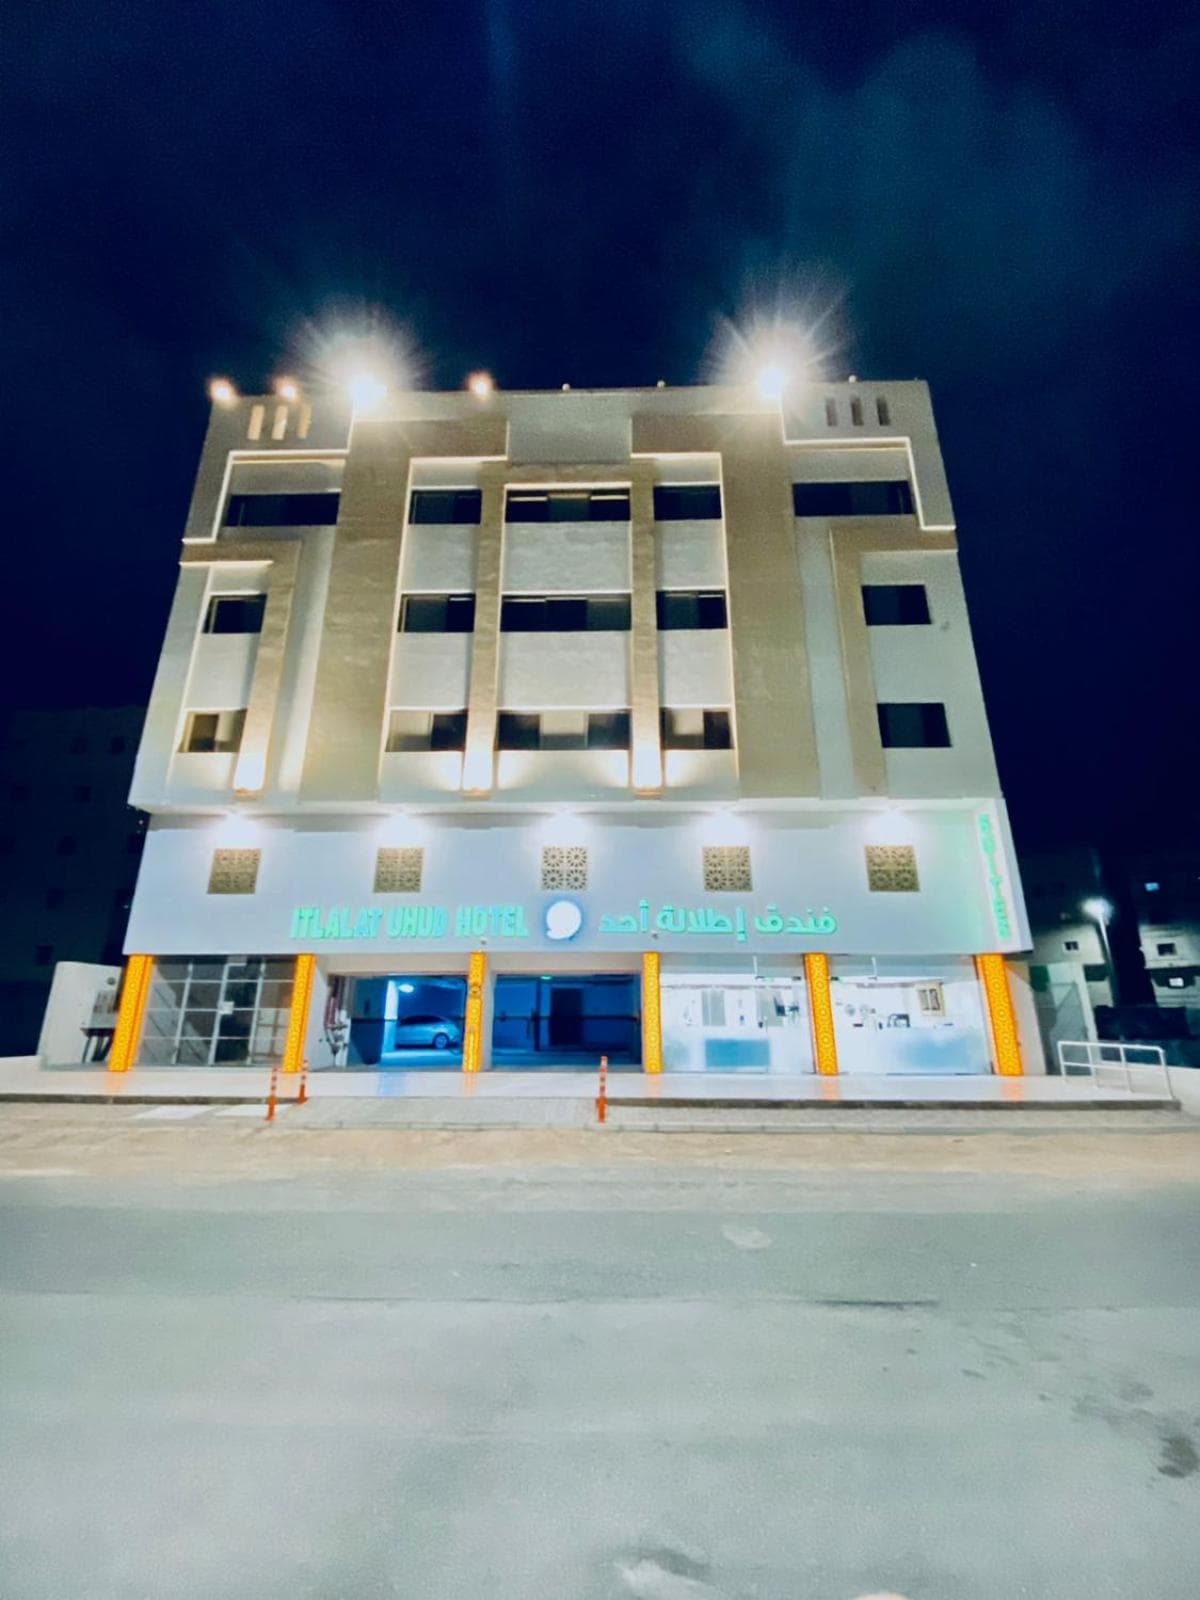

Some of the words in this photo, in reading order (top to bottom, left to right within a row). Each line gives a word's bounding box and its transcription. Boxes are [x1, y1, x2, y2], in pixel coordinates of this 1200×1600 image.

[290, 906, 383, 938] ITLALAT
[388, 906, 448, 938] UHUD
[455, 905, 529, 937] HOTEL
[599, 898, 650, 933] أحد
[656, 904, 749, 942] إطلالة
[754, 904, 838, 934] فندق
